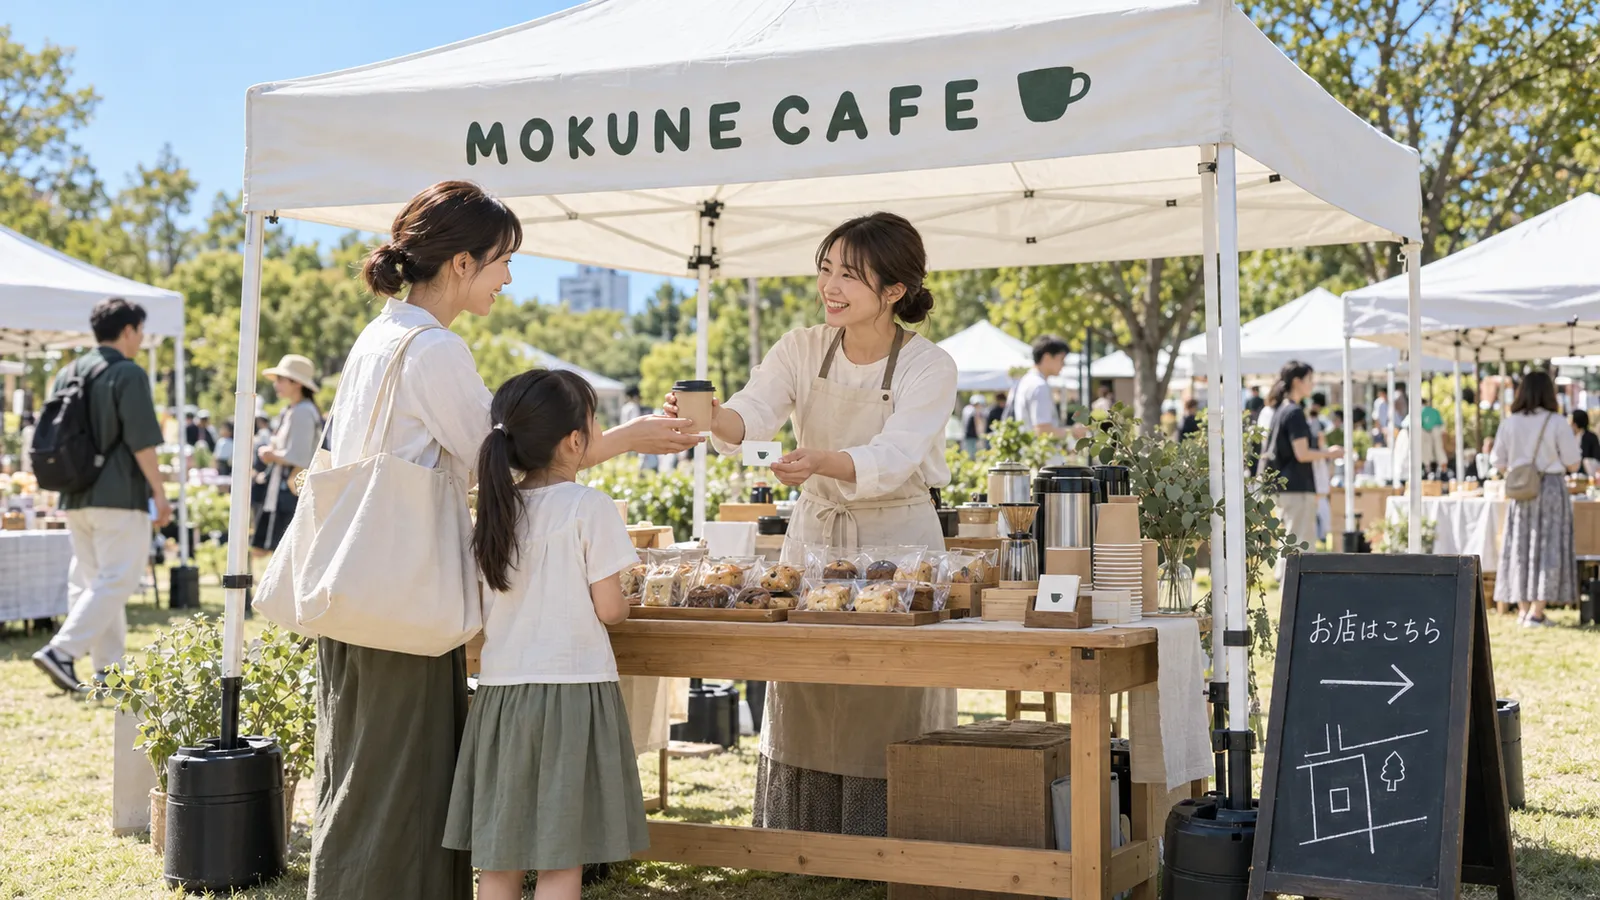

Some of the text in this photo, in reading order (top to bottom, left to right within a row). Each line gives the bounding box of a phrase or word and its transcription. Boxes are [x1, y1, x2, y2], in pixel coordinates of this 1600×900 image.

[465, 78, 979, 166] MOKUNE CAFE
[1309, 609, 1441, 645] お店はこちら
